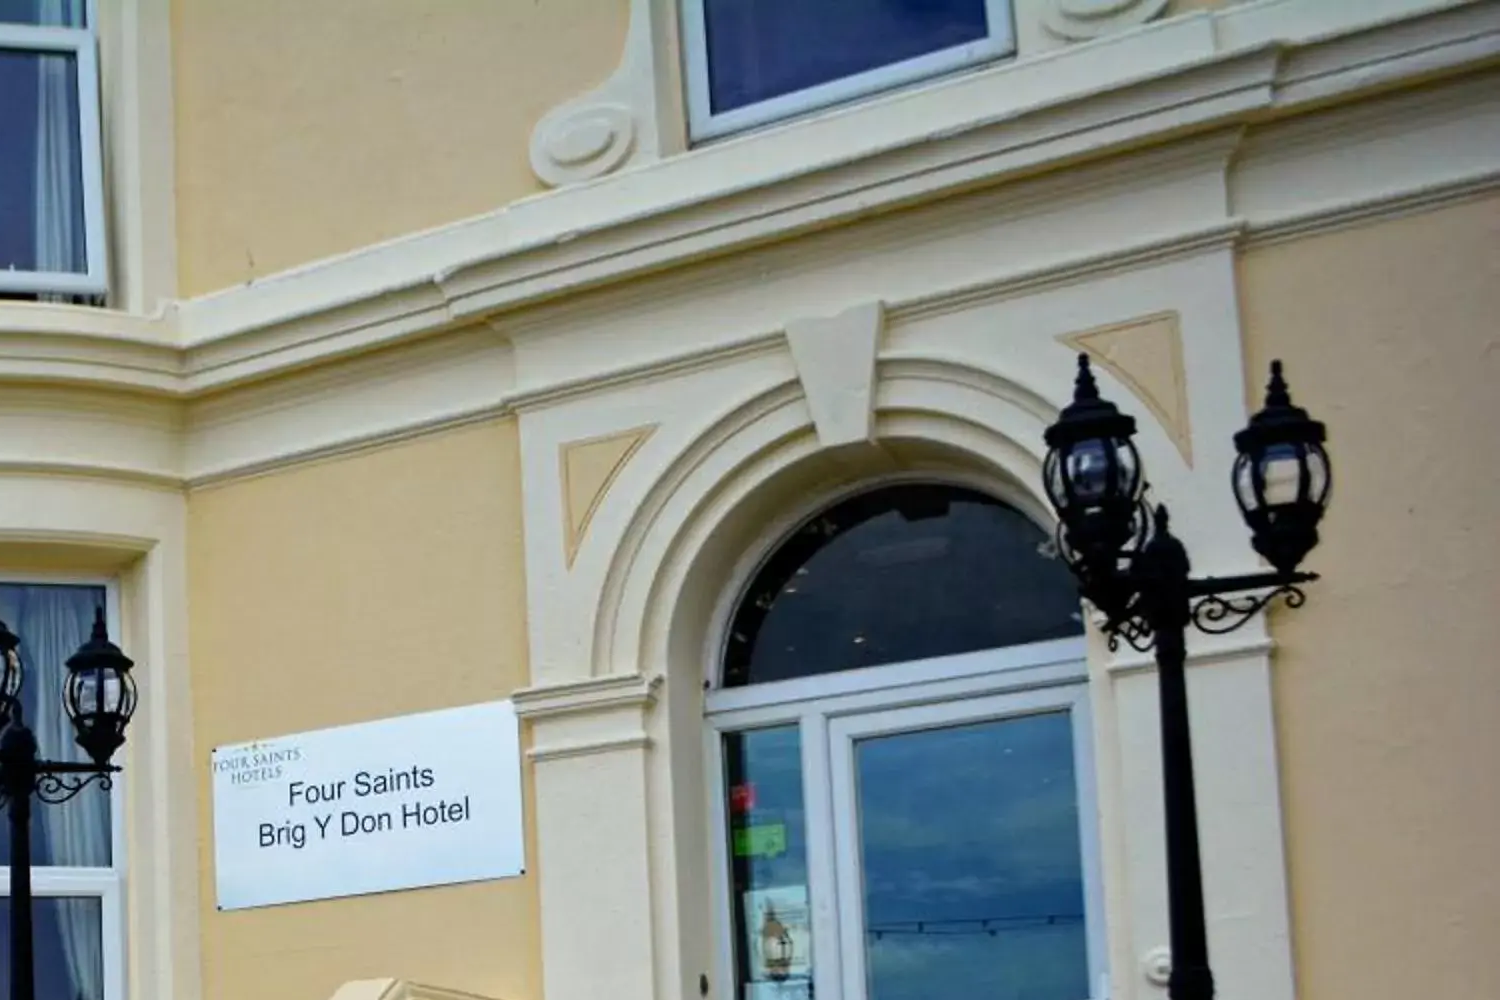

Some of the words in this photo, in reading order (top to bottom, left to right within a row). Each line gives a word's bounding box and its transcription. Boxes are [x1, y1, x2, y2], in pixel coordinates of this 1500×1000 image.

[253, 747, 303, 767] SAINTS
[231, 765, 282, 785] HOTELS
[289, 780, 346, 806] Four
[354, 765, 435, 797] Saints
[259, 820, 306, 848] Brig
[314, 813, 332, 839] Y
[341, 811, 392, 837] Don
[402, 795, 470, 829] Hotel
